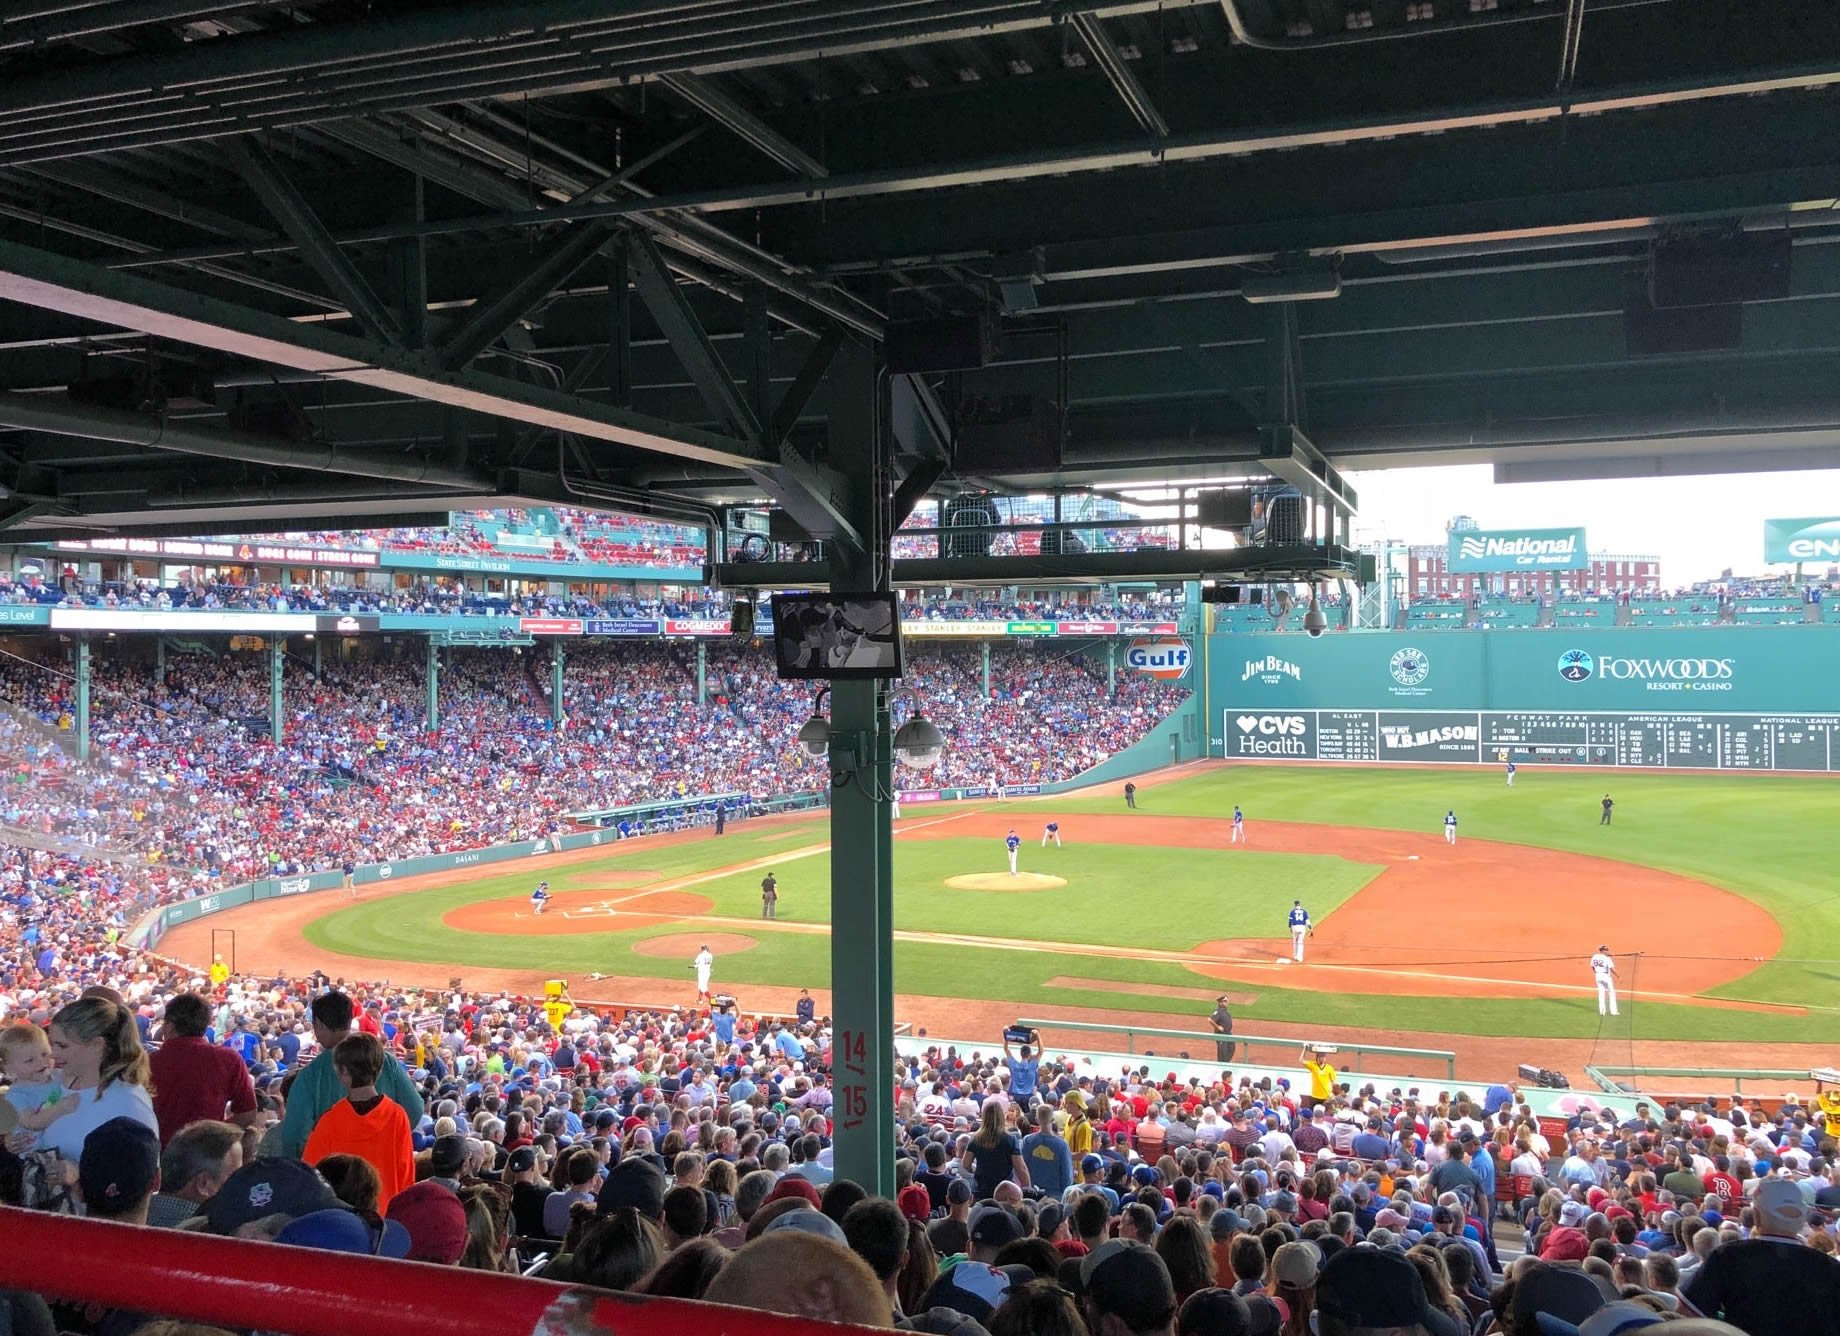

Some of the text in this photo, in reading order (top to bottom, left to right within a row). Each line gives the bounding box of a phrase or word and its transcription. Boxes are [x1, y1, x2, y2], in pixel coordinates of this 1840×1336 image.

[1486, 535, 1577, 556] National
[1516, 554, 1572, 564] Car Rental
[10, 609, 34, 620] Level
[674, 622, 726, 630] COGMEDIX
[926, 624, 960, 632] STANLEY
[968, 624, 1001, 632] STANLEY
[1130, 648, 1188, 666] Gulf
[1392, 650, 1422, 666] RED SOX
[1242, 656, 1302, 680] JIM BEAM
[1393, 662, 1427, 684] SCHOLARS
[1598, 656, 1733, 679] FOXWOODS
[1646, 682, 1732, 690] RESORT CASINO
[1258, 716, 1306, 734] CVS
[1239, 736, 1306, 754] Health
[455, 854, 480, 864] DASANI
[1593, 960, 1604, 968] 82
[842, 1030, 866, 1063] 14
[842, 1085, 867, 1117] 15
[924, 1104, 944, 1116] 24
[1713, 1177, 1732, 1202] B
